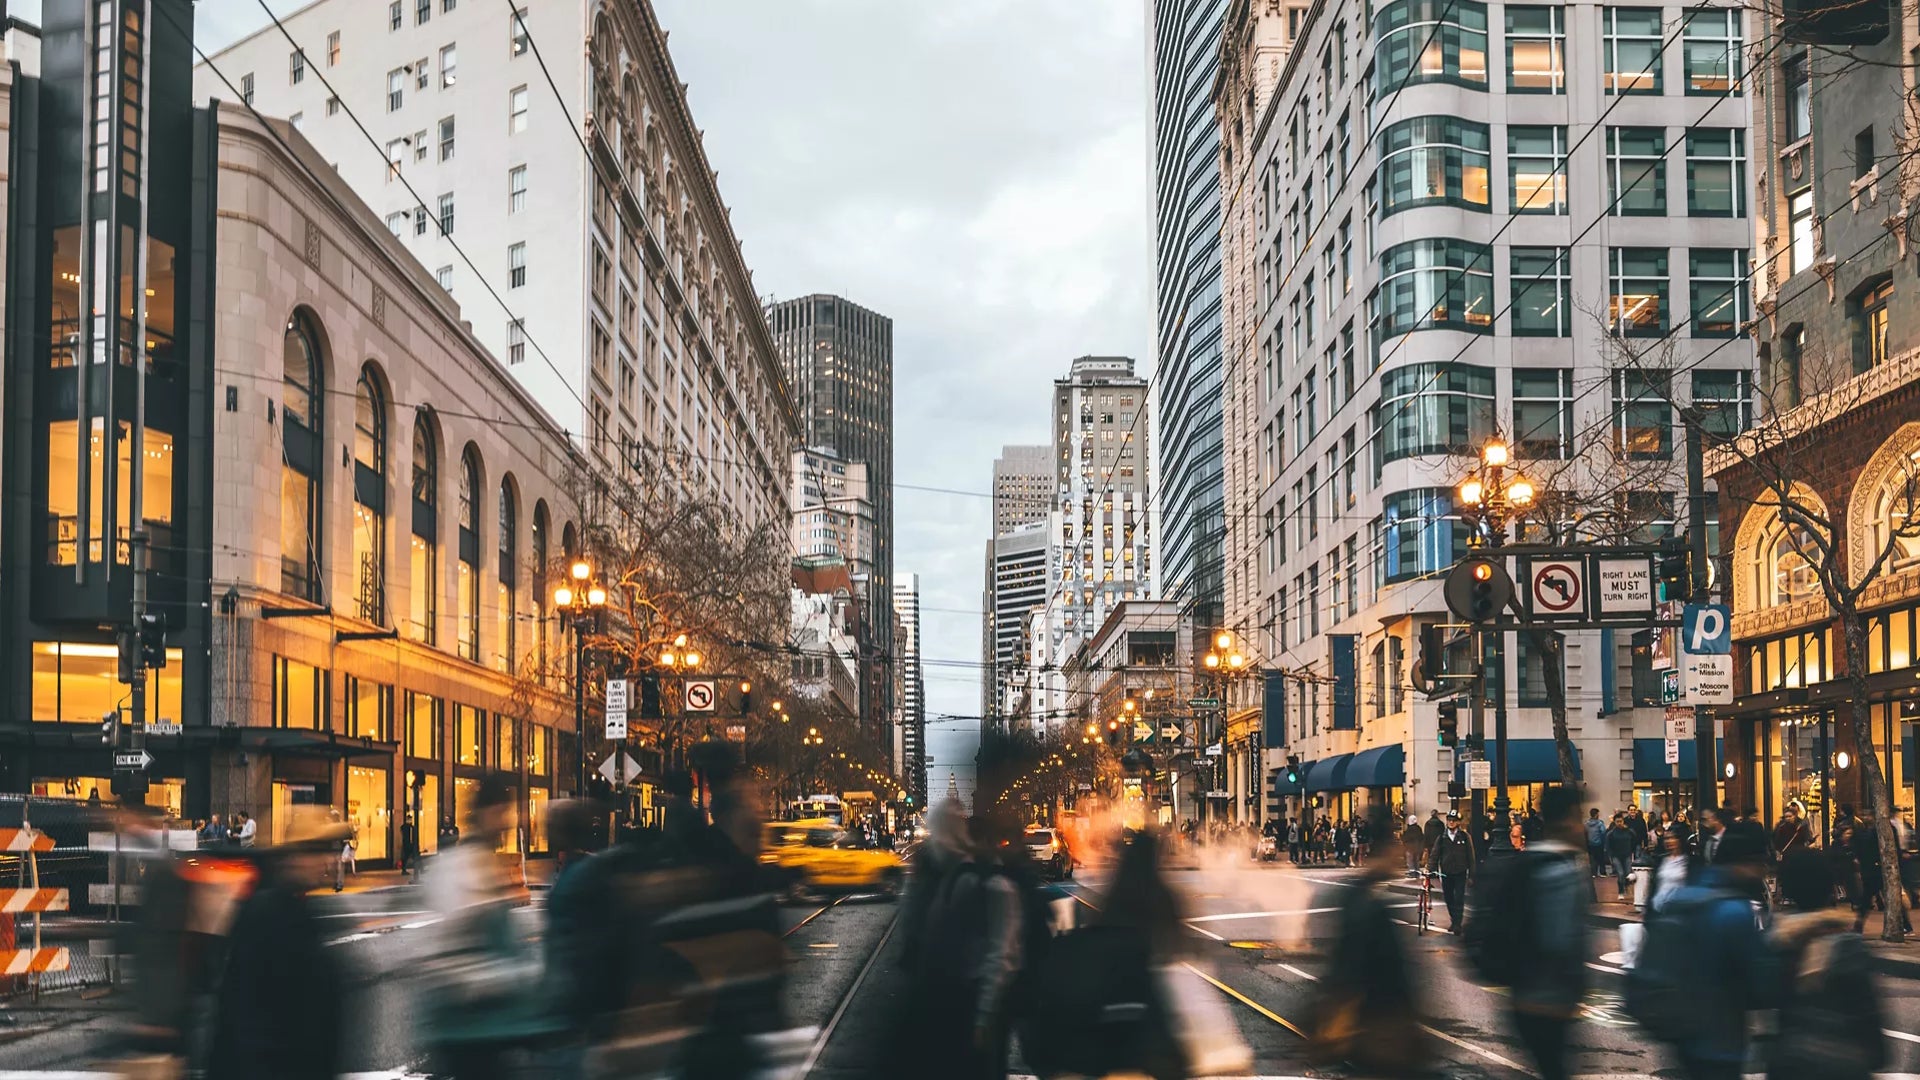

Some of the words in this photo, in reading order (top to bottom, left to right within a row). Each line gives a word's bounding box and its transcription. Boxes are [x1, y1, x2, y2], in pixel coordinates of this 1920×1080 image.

[1602, 571, 1623, 579] RIGHT
[1628, 571, 1647, 579] LANE
[1611, 581, 1640, 591] MUST
[1603, 593, 1623, 601] TURN
[1699, 662, 1710, 670] 5th
[1699, 669, 1725, 677] Mission
[117, 755, 128, 765] ONE
[130, 755, 141, 765] WAY
